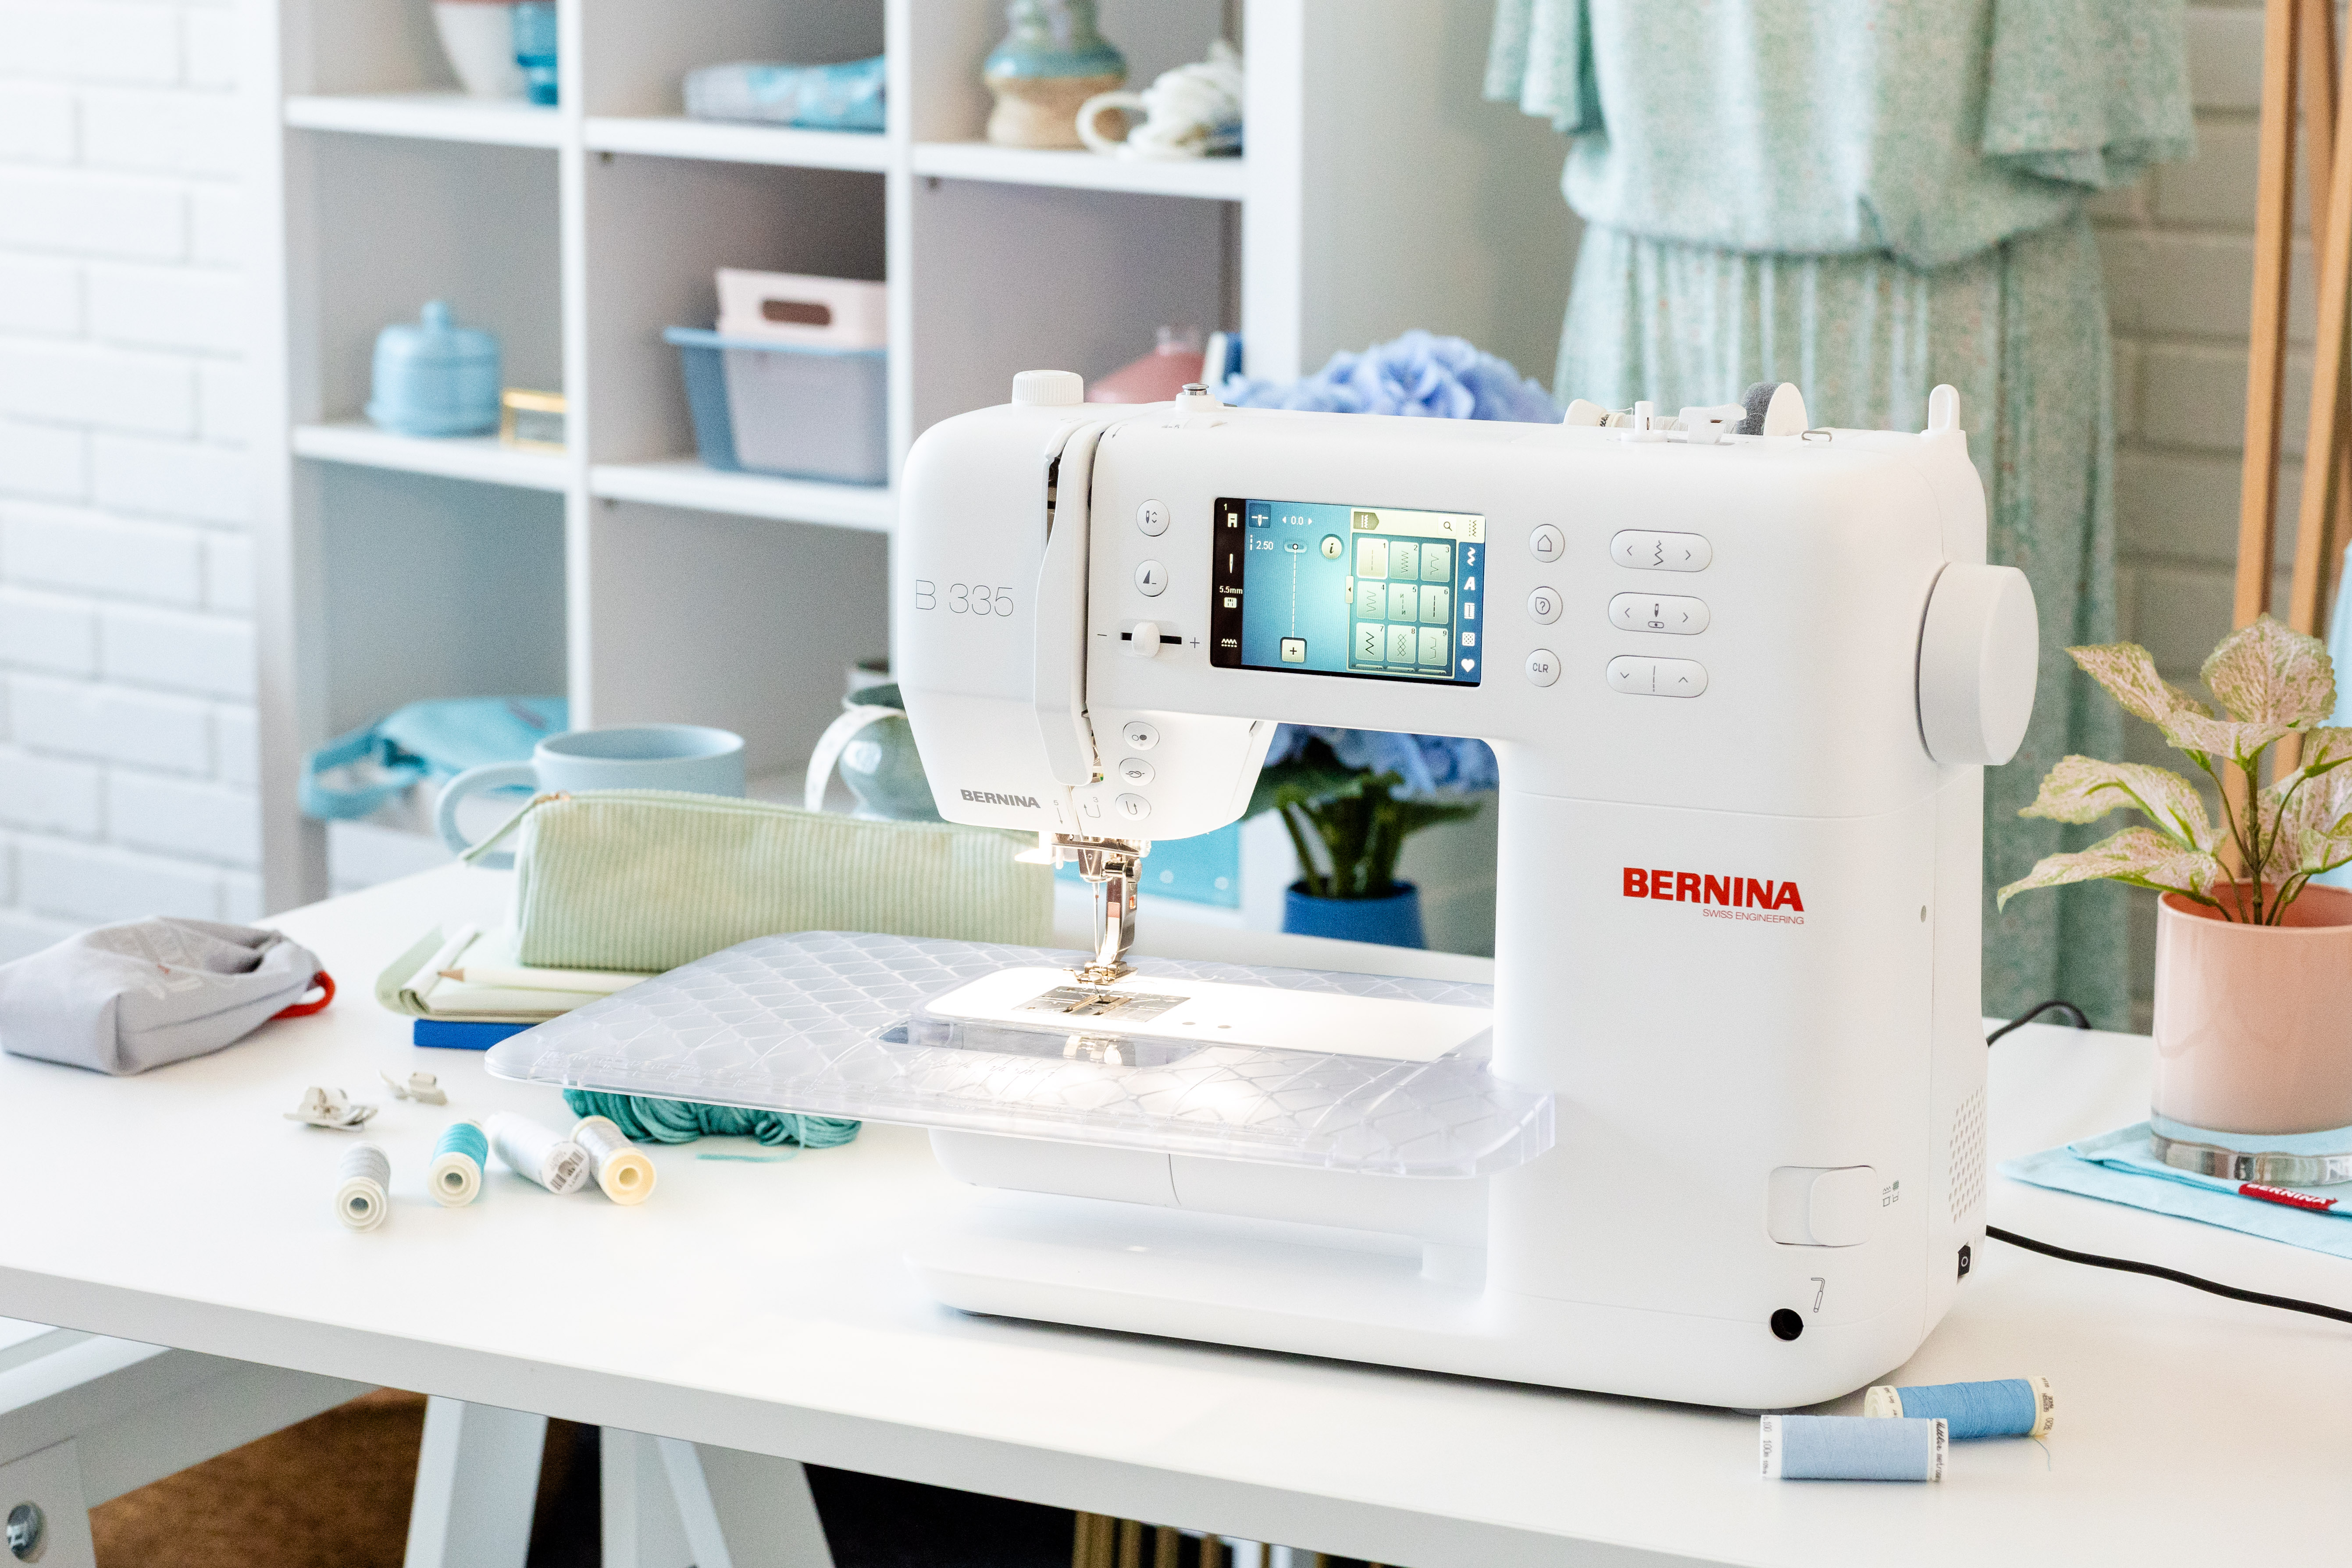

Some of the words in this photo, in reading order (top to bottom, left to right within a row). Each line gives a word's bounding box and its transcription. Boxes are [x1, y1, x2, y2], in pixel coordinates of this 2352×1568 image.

[1291, 516, 1304, 525] 0.0
[1256, 541, 1273, 550] 2.50
[1219, 585, 1243, 594] 5.5mm
[916, 579, 936, 610] B
[949, 583, 1014, 617] 335
[1532, 663, 1549, 674] CLR
[960, 789, 1041, 809] BERNINA
[1623, 867, 1805, 912] BERNINA
[1703, 909, 1733, 919] SWISS
[1735, 912, 1805, 925] ENGINEERING
